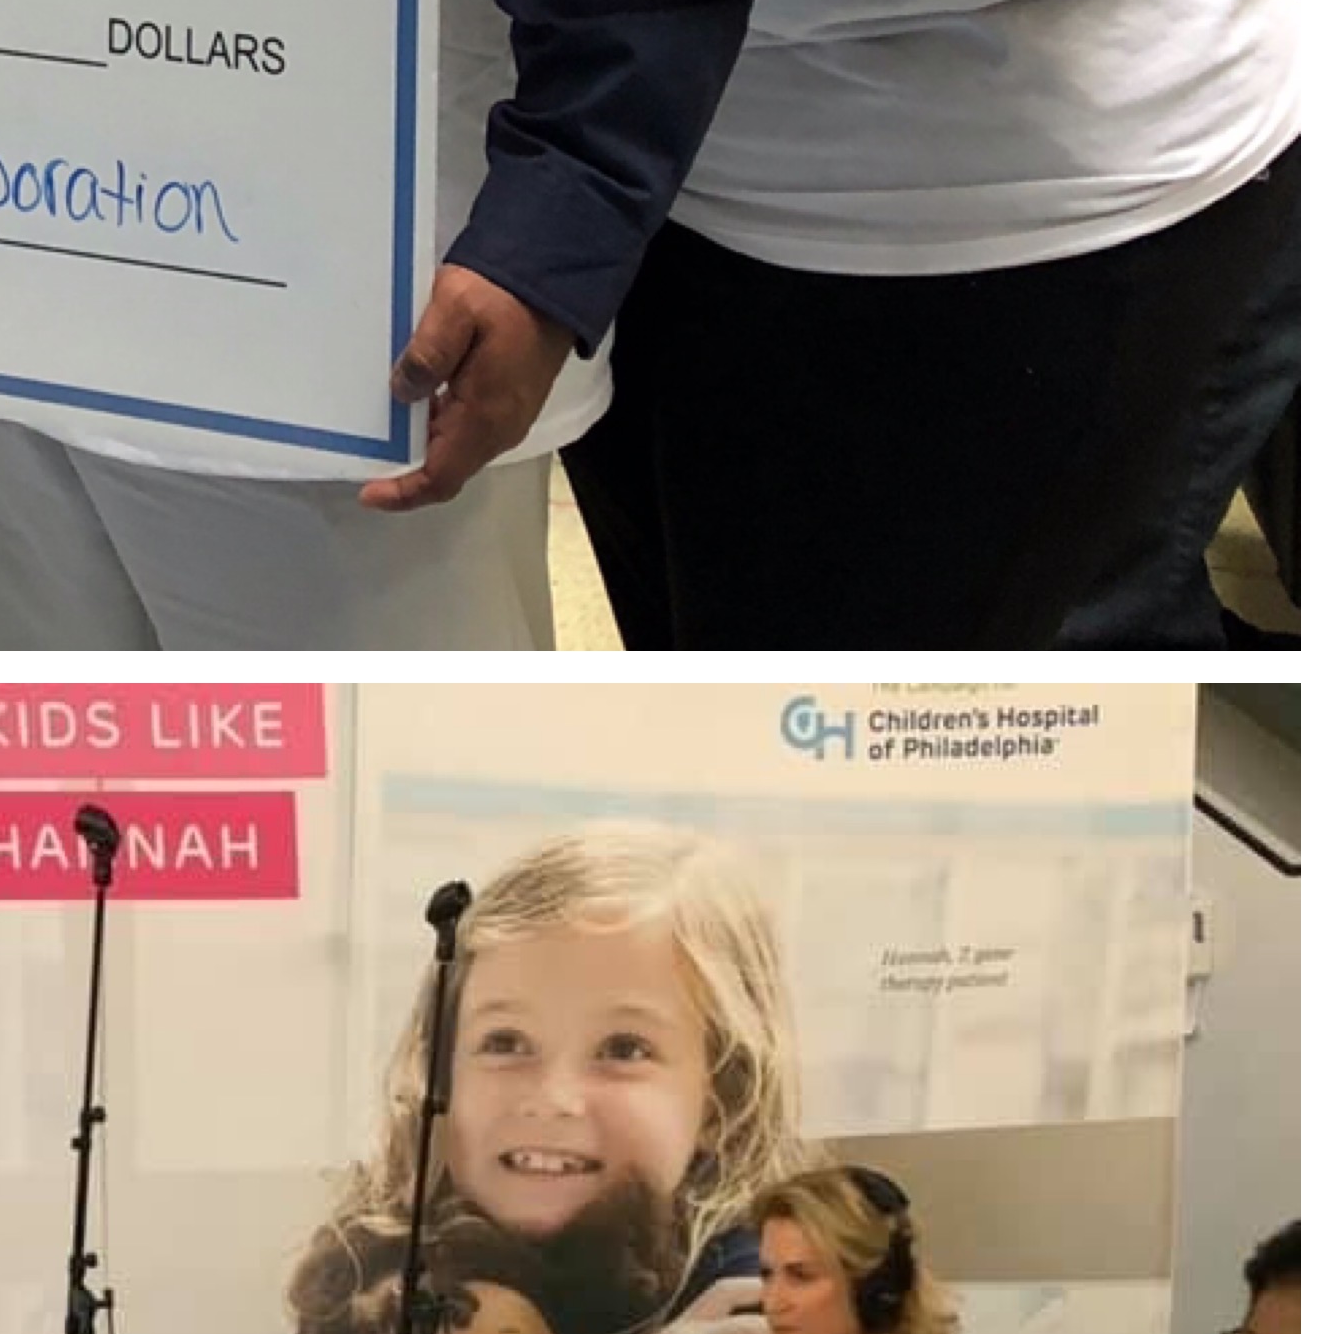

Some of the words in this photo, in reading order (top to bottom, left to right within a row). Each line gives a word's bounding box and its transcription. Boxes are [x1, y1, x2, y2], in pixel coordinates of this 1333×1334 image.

[107, 16, 286, 76] DOLLARS
[150, 699, 284, 751] LIKE
[868, 707, 990, 733] Children's
[996, 704, 1100, 730] Hospital
[868, 737, 895, 760] of
[903, 734, 1056, 760] Philadelphia
